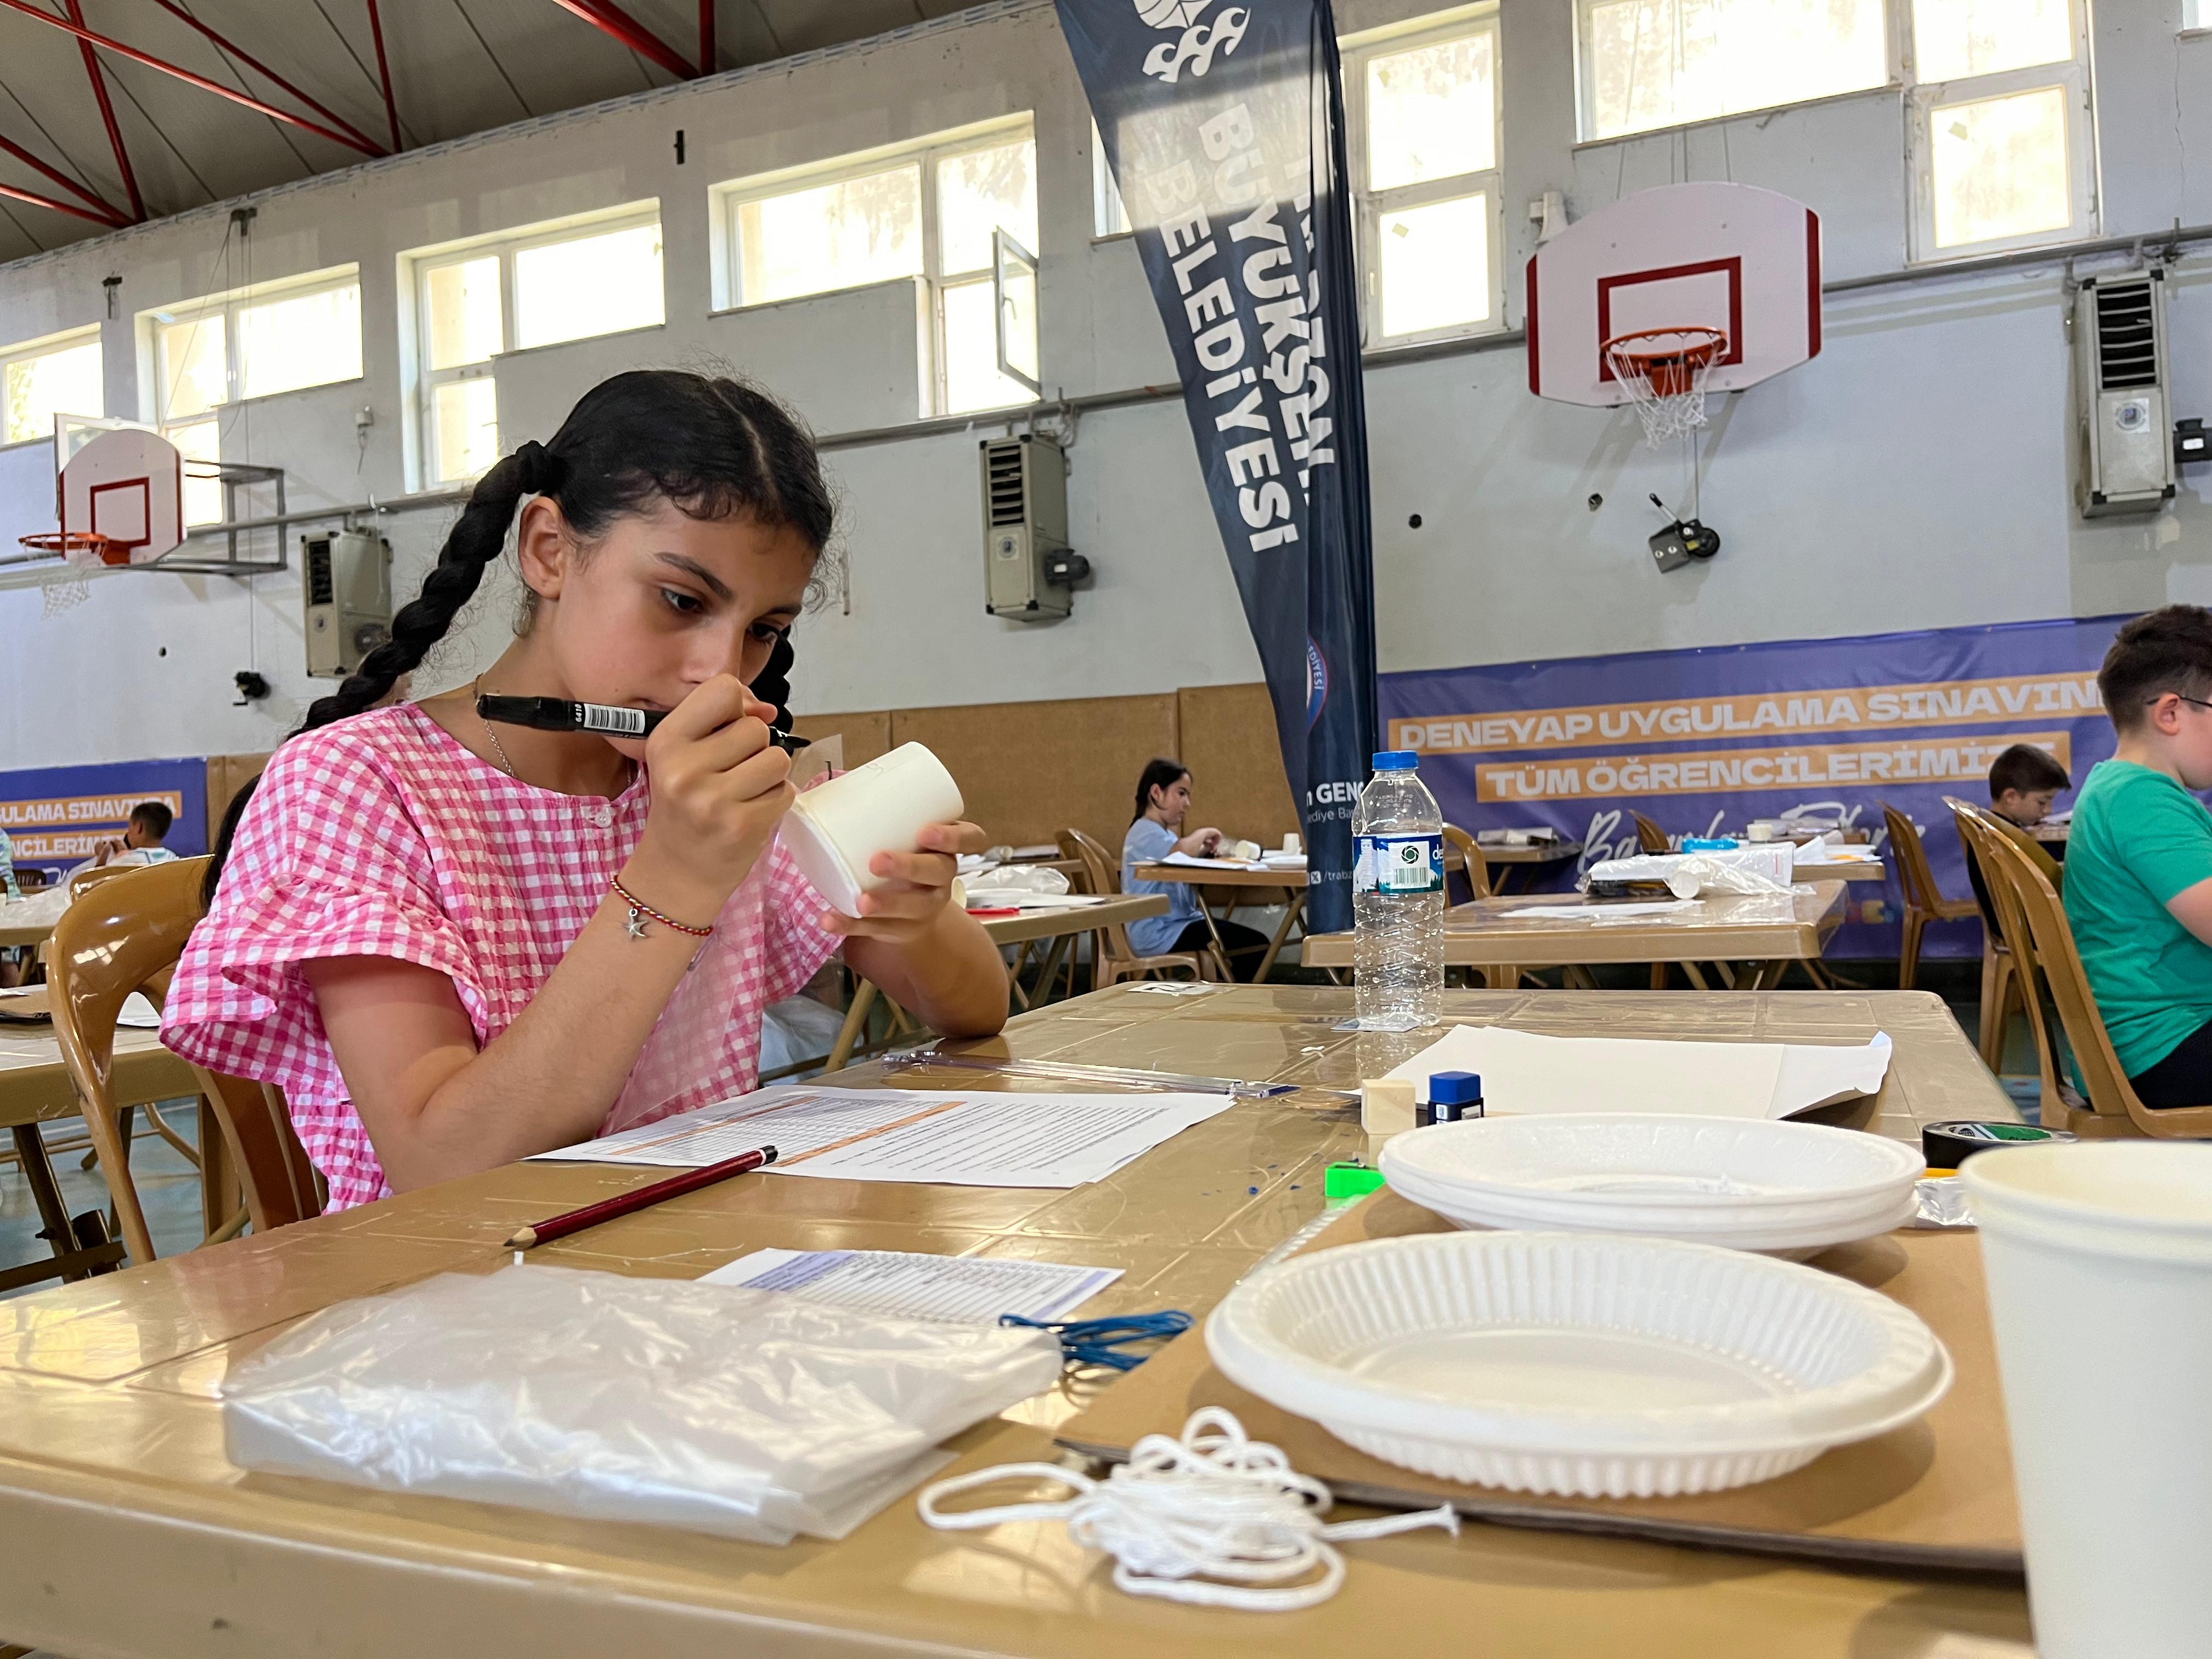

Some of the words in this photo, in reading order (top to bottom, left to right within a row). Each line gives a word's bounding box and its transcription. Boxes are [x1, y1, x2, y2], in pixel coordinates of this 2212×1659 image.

[1198, 103, 1310, 506] BÜYÜKŞE
[1143, 159, 1299, 553] BELEDİYESİ
[574, 704, 583, 723] 6410
[1400, 714, 1593, 749] DENEYAP
[1599, 696, 1860, 738] UYGULAMA
[1867, 679, 2106, 722] SINAVIN
[1486, 764, 1581, 797] TÜM
[1587, 741, 2055, 793] ÖĞRENCİLERİMİ
[0, 804, 66, 824] ULAMA
